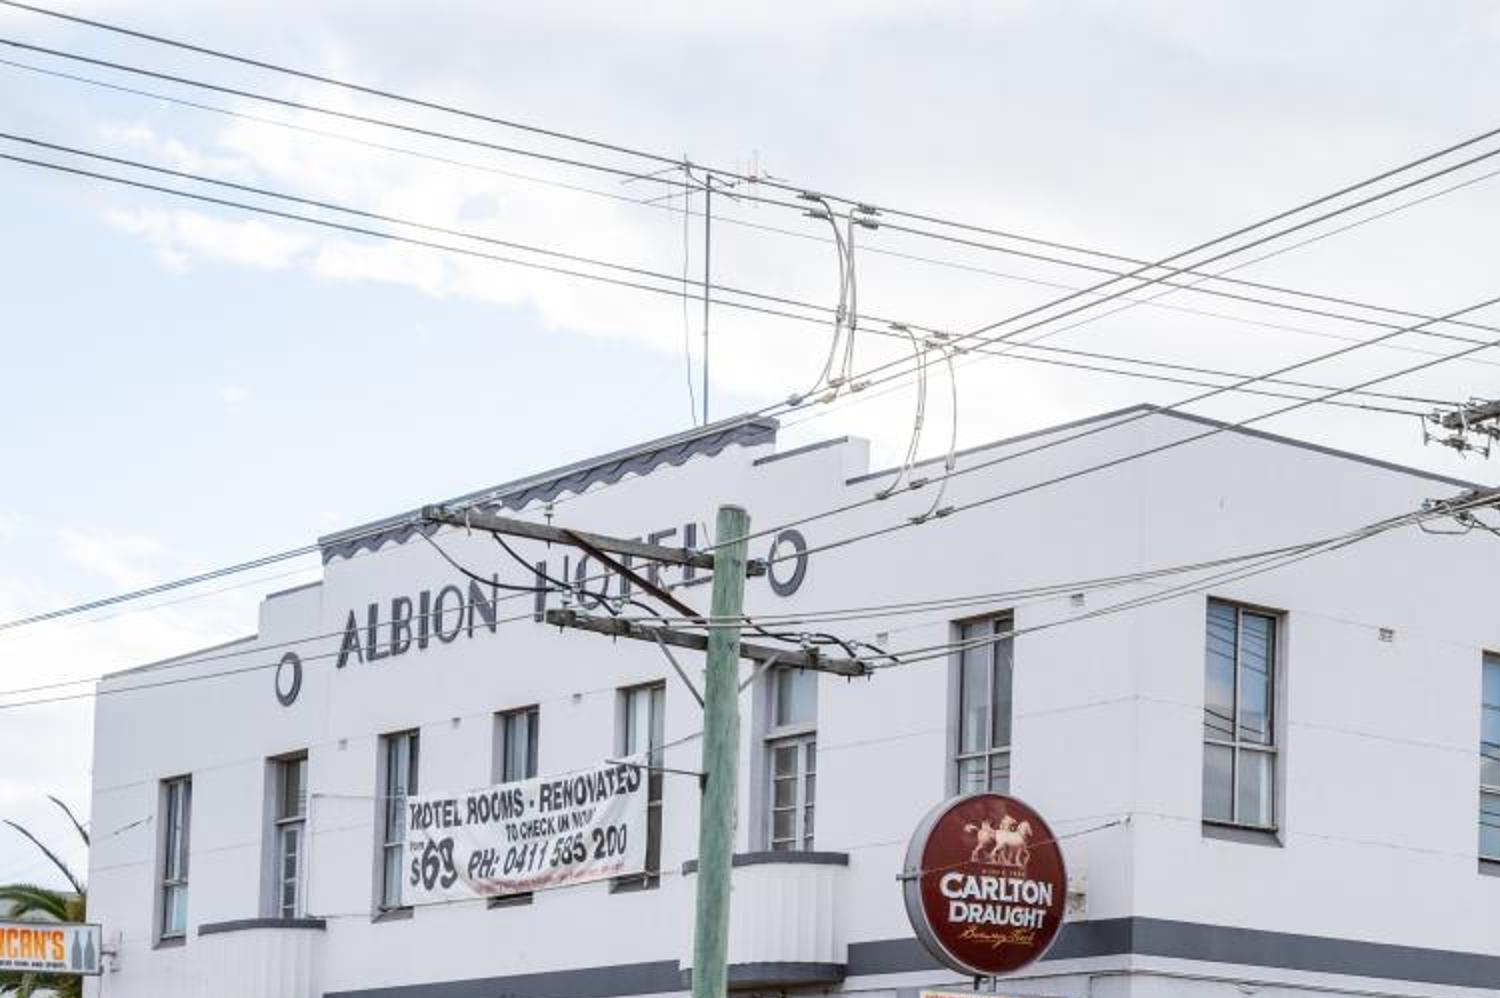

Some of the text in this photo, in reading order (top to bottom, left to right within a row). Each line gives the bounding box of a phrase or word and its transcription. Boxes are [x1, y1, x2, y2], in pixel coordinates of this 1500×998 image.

[336, 572, 499, 669] ALBION
[466, 788, 525, 825] ROOMS
[539, 763, 641, 814] RENOVATED
[468, 847, 500, 880] PH:
[503, 831, 549, 876] 0411
[550, 832, 588, 868] 585
[592, 823, 628, 860] 200
[505, 824, 518, 842] TO
[519, 817, 555, 839] CHECK
[939, 871, 1054, 907] CARLTON
[948, 901, 1047, 929] DRAUGHT
